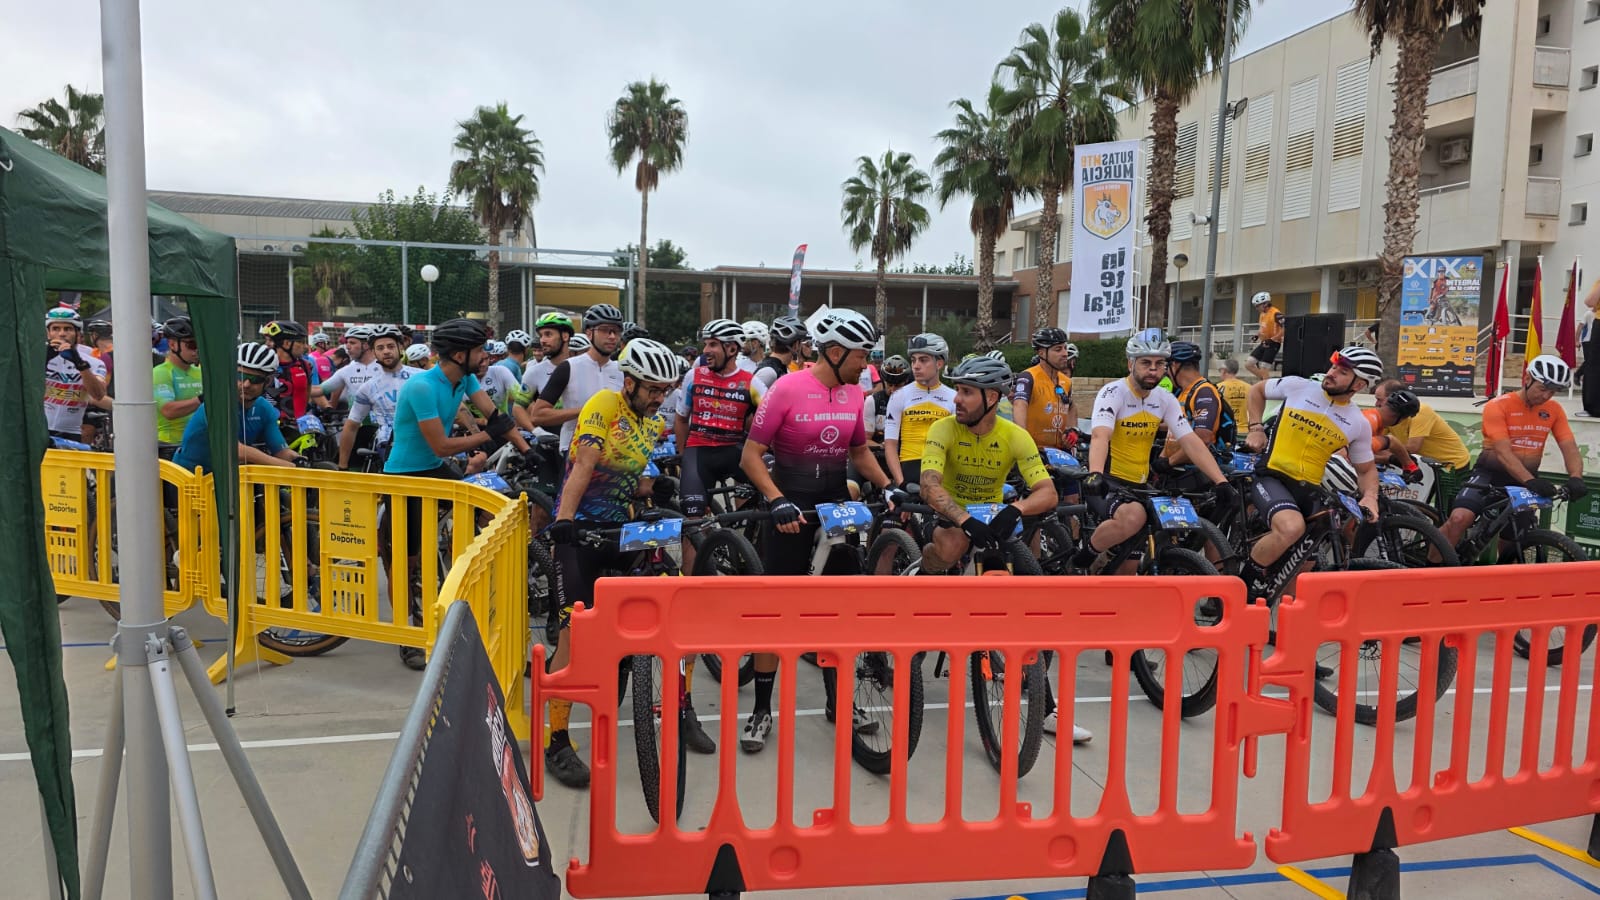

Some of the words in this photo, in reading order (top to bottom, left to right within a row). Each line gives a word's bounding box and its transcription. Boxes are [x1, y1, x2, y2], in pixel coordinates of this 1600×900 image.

[1405, 258, 1462, 279] XIX
[695, 386, 745, 401] bicihuerta
[1121, 420, 1158, 429] LEMONTE
[1288, 410, 1345, 443] LEMONTEAM
[49, 502, 77, 514] Deportes
[832, 506, 857, 519] 639
[1167, 506, 1186, 515] 667
[637, 524, 665, 534] 741
[330, 532, 366, 545] Deportes
[1266, 534, 1315, 598] S-WORKS
